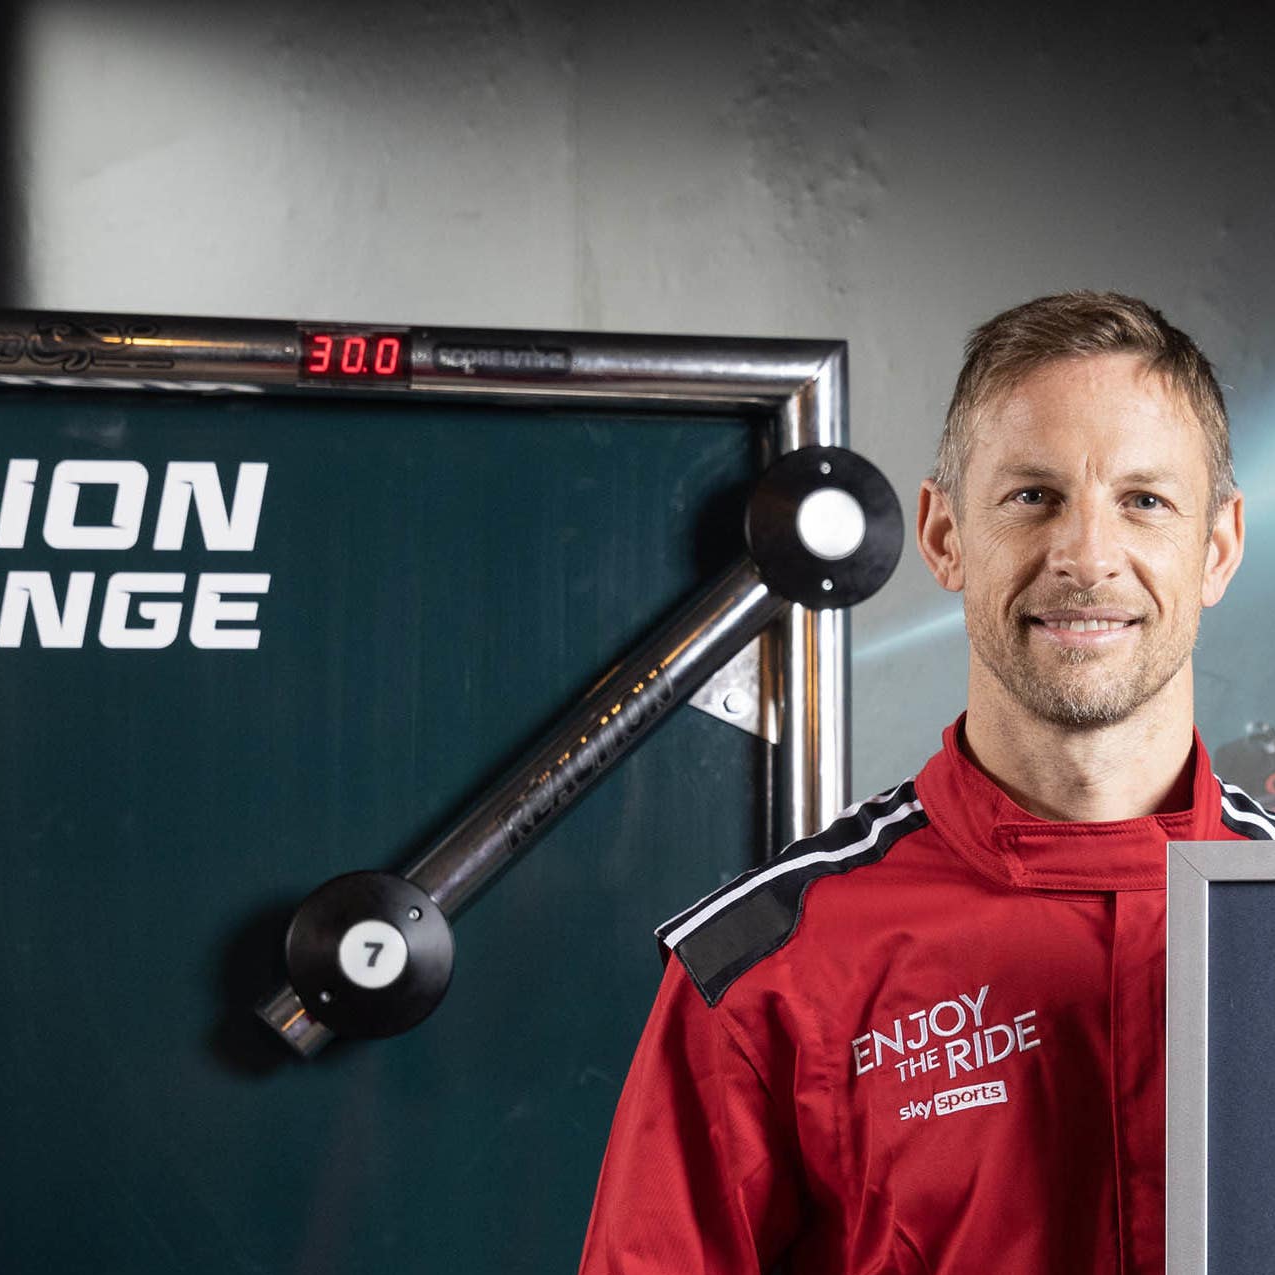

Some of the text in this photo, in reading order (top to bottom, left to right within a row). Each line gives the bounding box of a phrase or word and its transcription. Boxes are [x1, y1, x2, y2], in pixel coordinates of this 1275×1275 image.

[308, 335, 402, 375] 30.0
[363, 941, 385, 968] 7
[851, 985, 989, 1077] ENJOY
[894, 1010, 1041, 1082] THE RIDE
[899, 1083, 1003, 1121] sky sports
